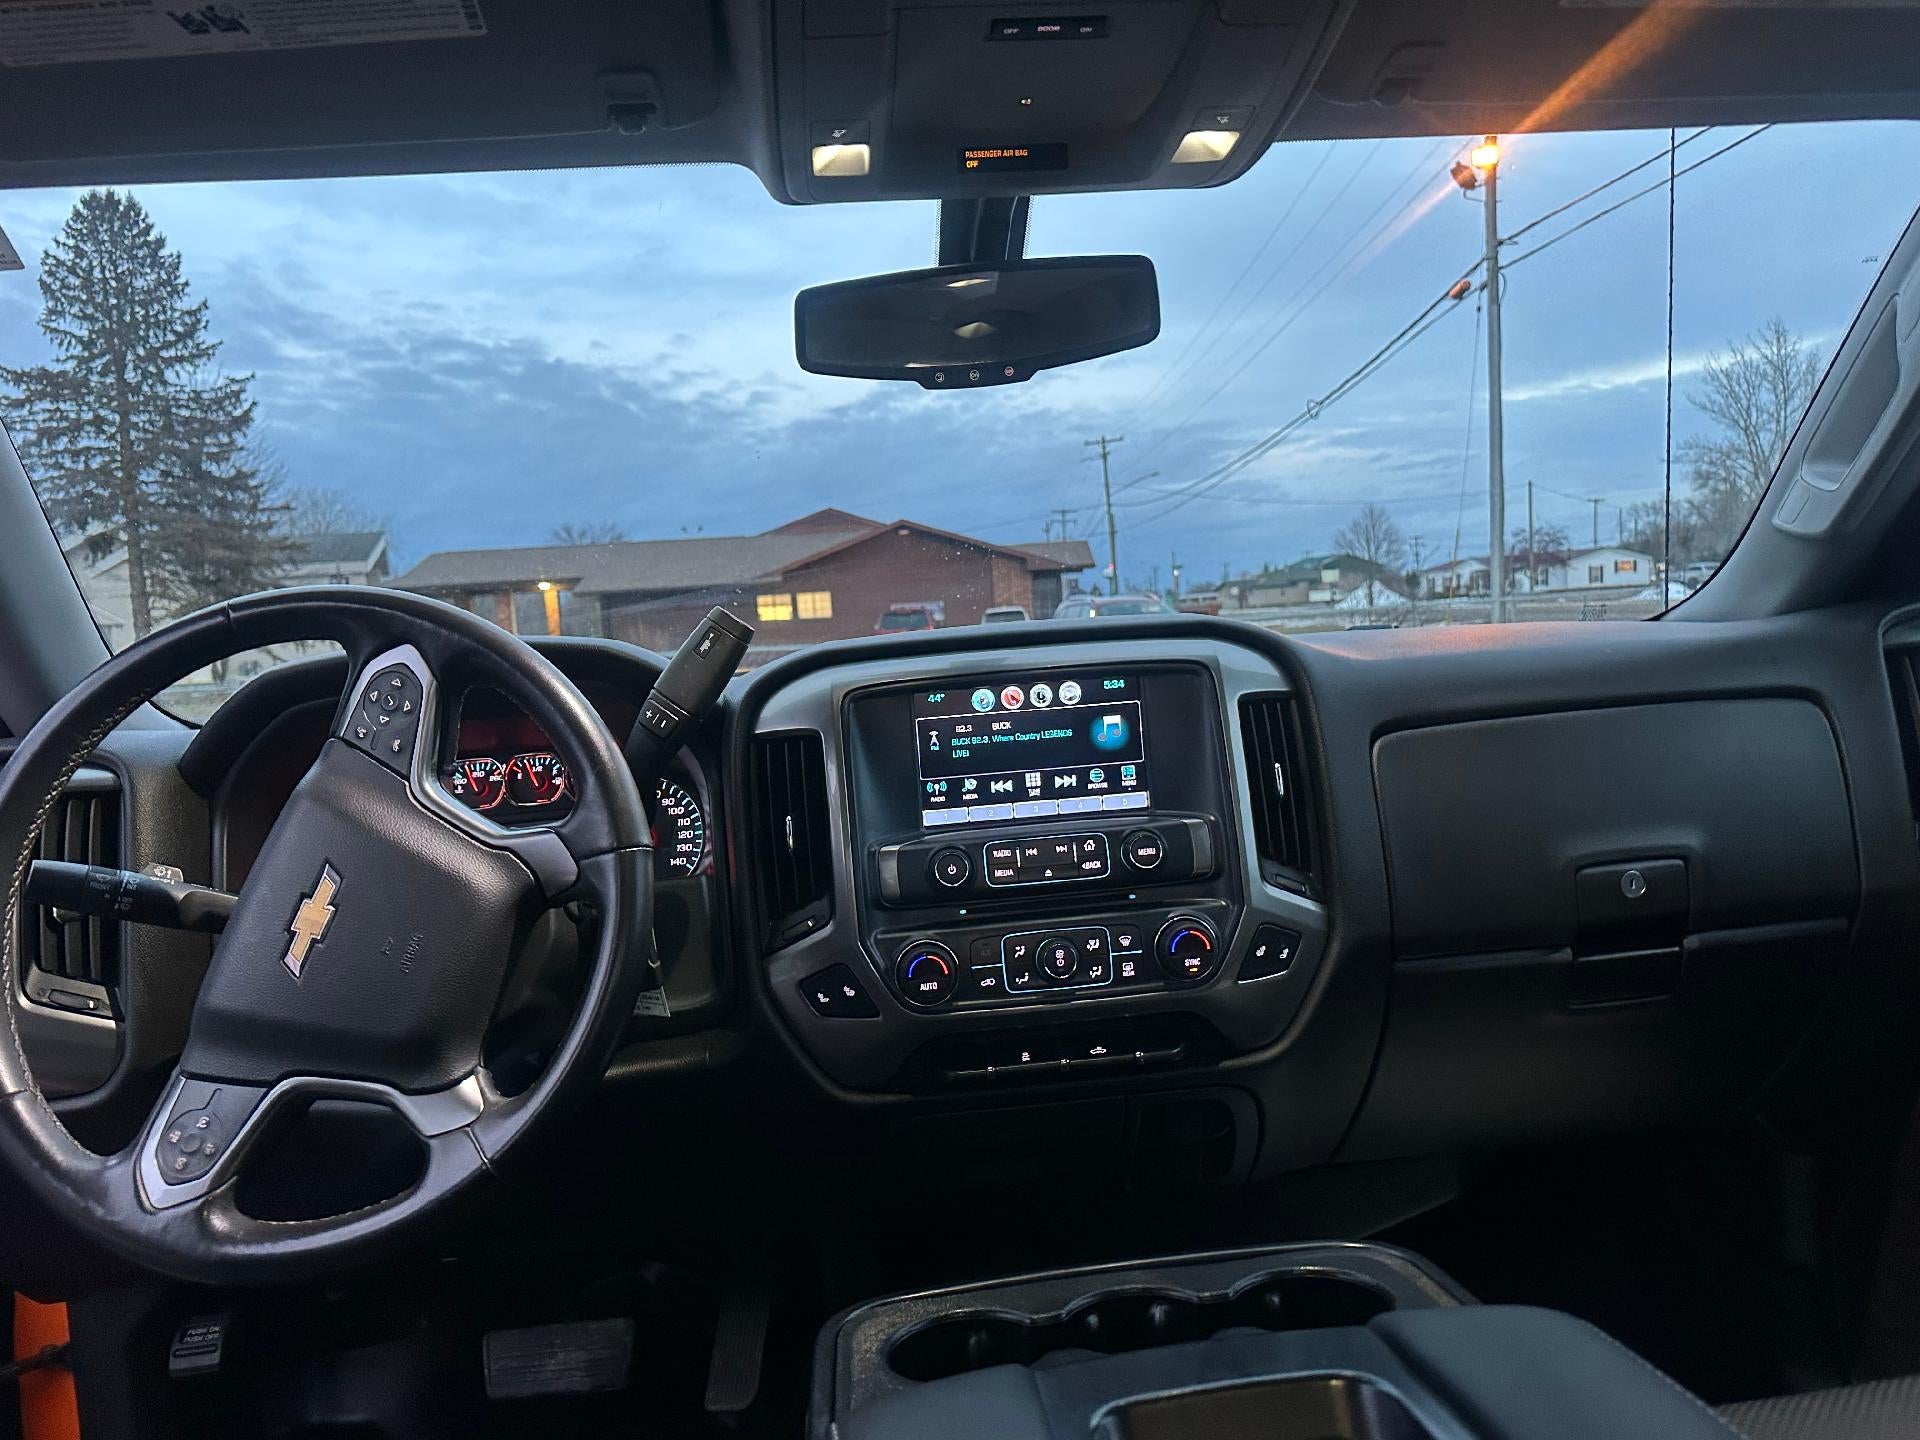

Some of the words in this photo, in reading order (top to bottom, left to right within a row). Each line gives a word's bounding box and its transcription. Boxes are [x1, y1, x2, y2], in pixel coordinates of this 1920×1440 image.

[965, 150, 1002, 158] PASSENGER
[1002, 149, 1015, 157] AIR
[966, 160, 979, 168] OFF
[1103, 679, 1125, 690] 5:34
[955, 724, 973, 733] 92.3
[991, 721, 1012, 731] BUCK
[951, 738, 971, 746] BUCK
[991, 734, 1015, 743] Where
[1014, 731, 1041, 741] Country
[1040, 728, 1073, 739] LEGENDS
[472, 770, 485, 778] 210
[1087, 782, 1108, 790] BROWSE
[661, 797, 675, 806] 90
[962, 793, 979, 801] MEDIA
[667, 806, 685, 816] 100
[677, 818, 691, 827] 110
[677, 830, 694, 839] 120
[676, 843, 693, 852] 130
[1137, 847, 1157, 856] MENU
[992, 849, 1012, 859] RADIO
[669, 857, 687, 866] 140
[994, 868, 1014, 878] MEDIA
[1184, 957, 1201, 967] SYNC
[920, 981, 938, 991] AUTO
